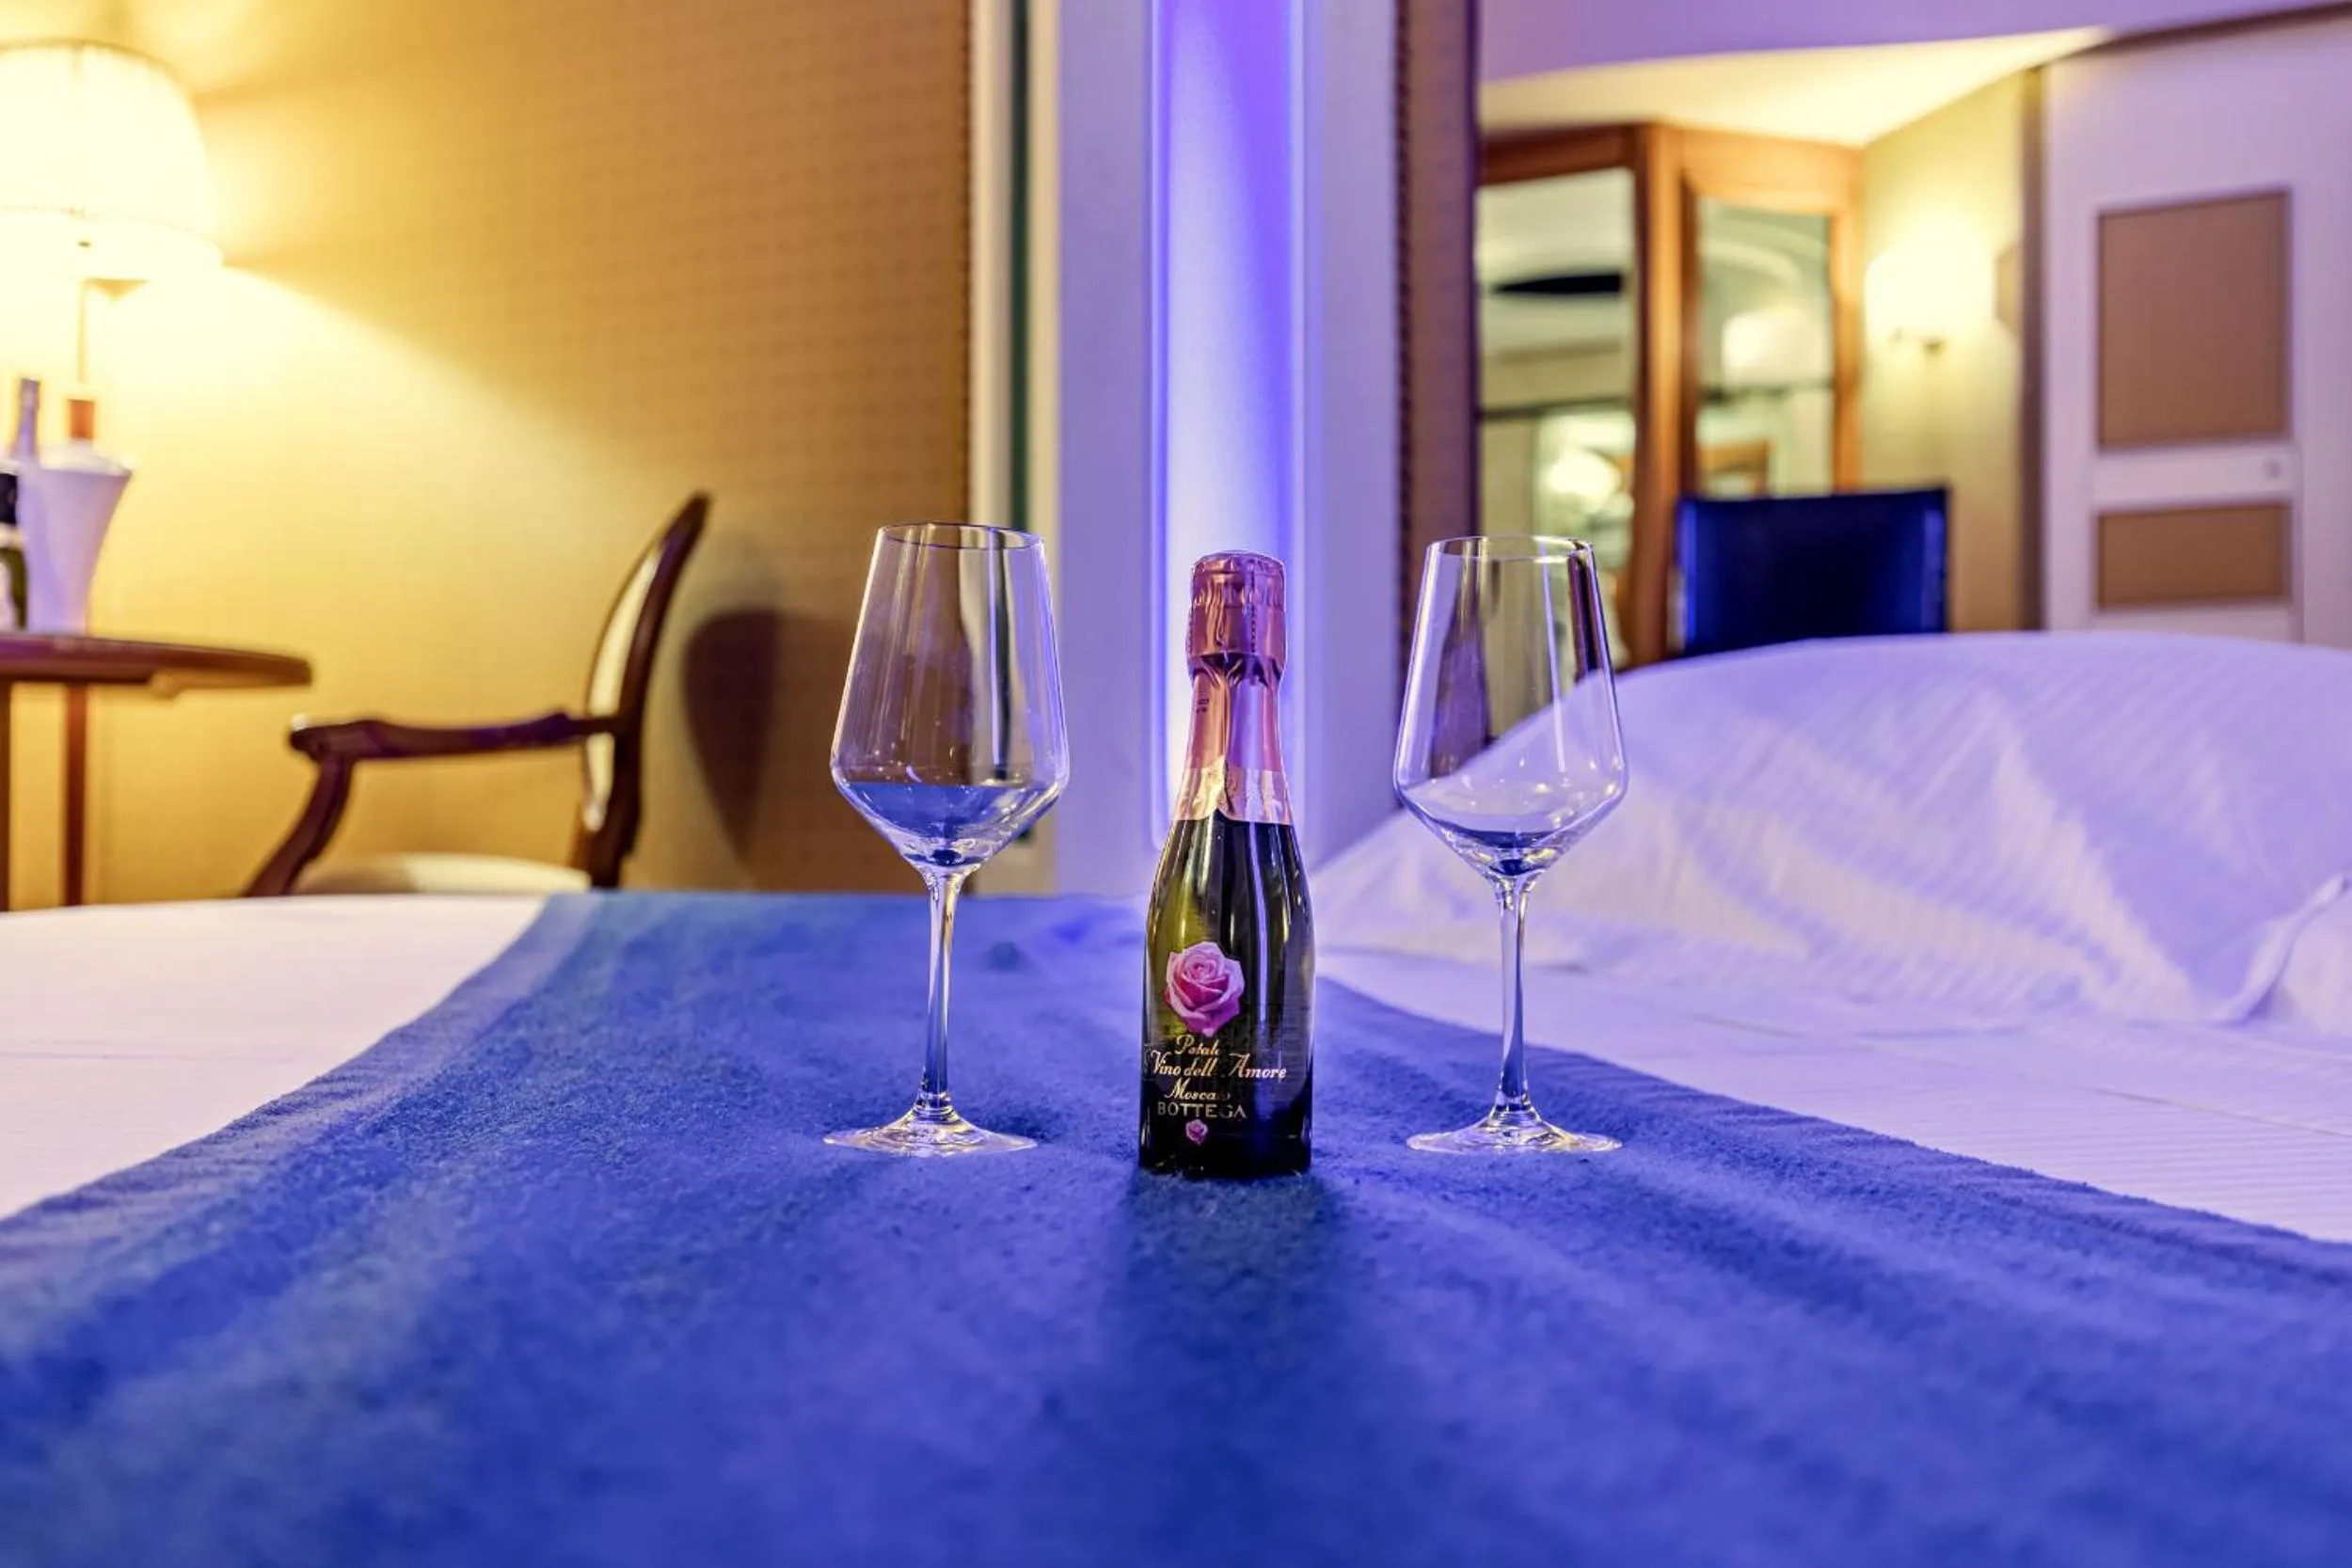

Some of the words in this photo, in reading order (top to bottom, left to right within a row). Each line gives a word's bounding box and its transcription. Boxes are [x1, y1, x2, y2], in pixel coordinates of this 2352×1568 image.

[1151, 1050, 1181, 1076] Vino
[1228, 1053, 1288, 1079] Amore
[1164, 1078, 1231, 1101] Moscao
[1157, 1101, 1248, 1119] BOTTEGA
